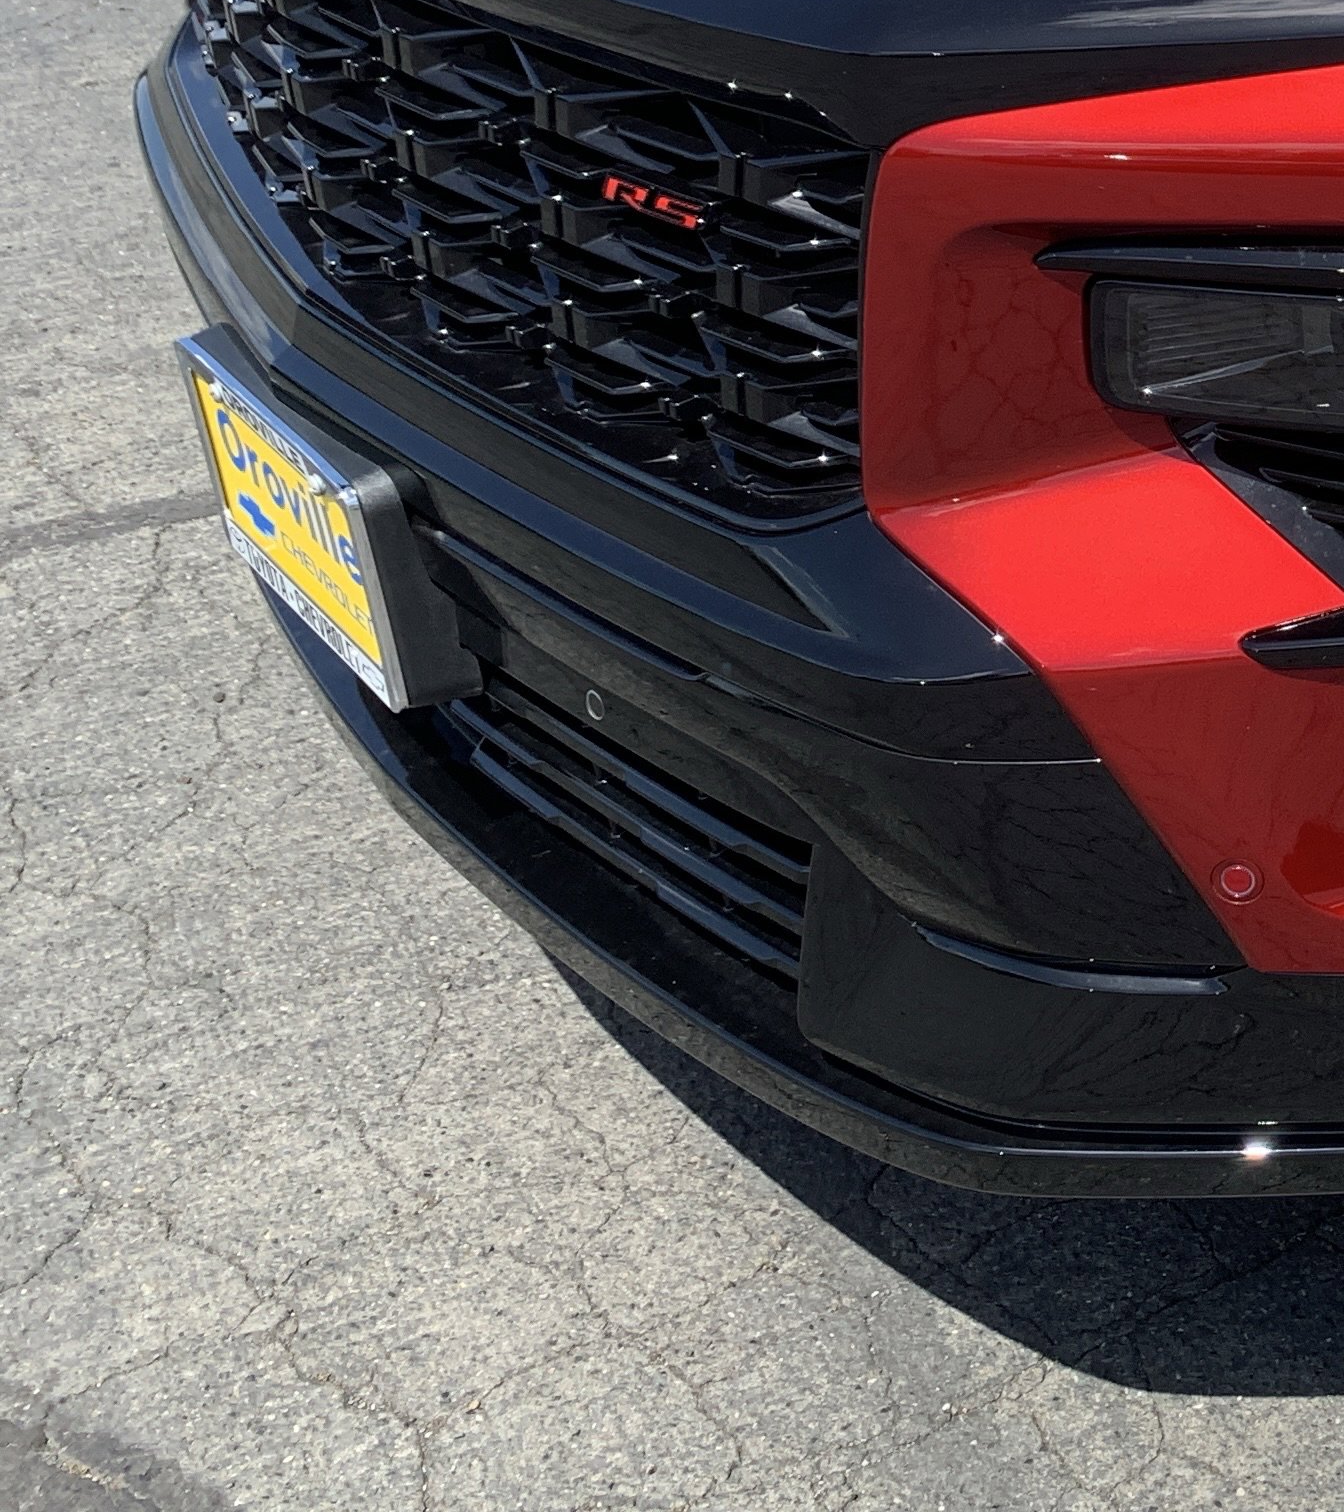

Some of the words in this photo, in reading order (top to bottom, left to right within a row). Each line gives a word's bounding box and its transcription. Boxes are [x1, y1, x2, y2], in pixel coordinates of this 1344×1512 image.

[603, 177, 703, 230] RS
[222, 386, 305, 471] OROVILLE
[216, 411, 363, 586] Oroville
[281, 531, 376, 635] CHEVROLET
